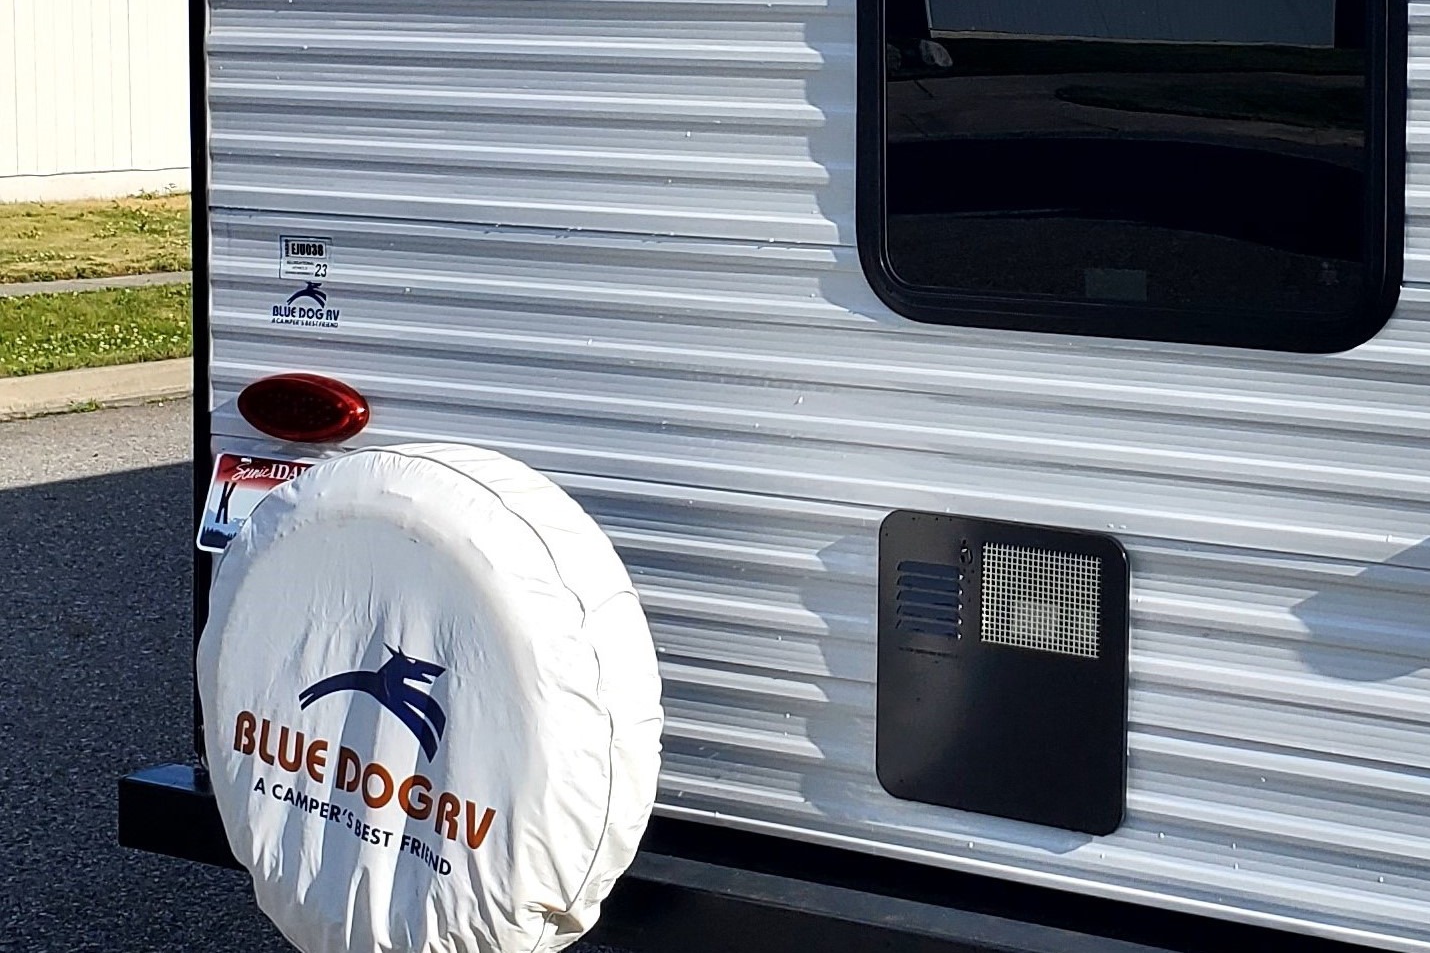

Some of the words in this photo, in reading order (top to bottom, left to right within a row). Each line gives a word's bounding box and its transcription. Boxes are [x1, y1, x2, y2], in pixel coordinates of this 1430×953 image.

[315, 264, 328, 277] 23
[273, 305, 296, 318] BLUE
[299, 308, 324, 320] DOG
[326, 309, 340, 321] RV
[231, 462, 272, 481] Scenic
[214, 480, 237, 525] K
[233, 710, 328, 784] BLUE
[335, 745, 434, 821] DOG
[434, 791, 497, 850] RV
[253, 777, 267, 795] A
[271, 784, 353, 829] CAMPER'S
[354, 822, 394, 848] BEST
[400, 834, 452, 876] FRIEND
